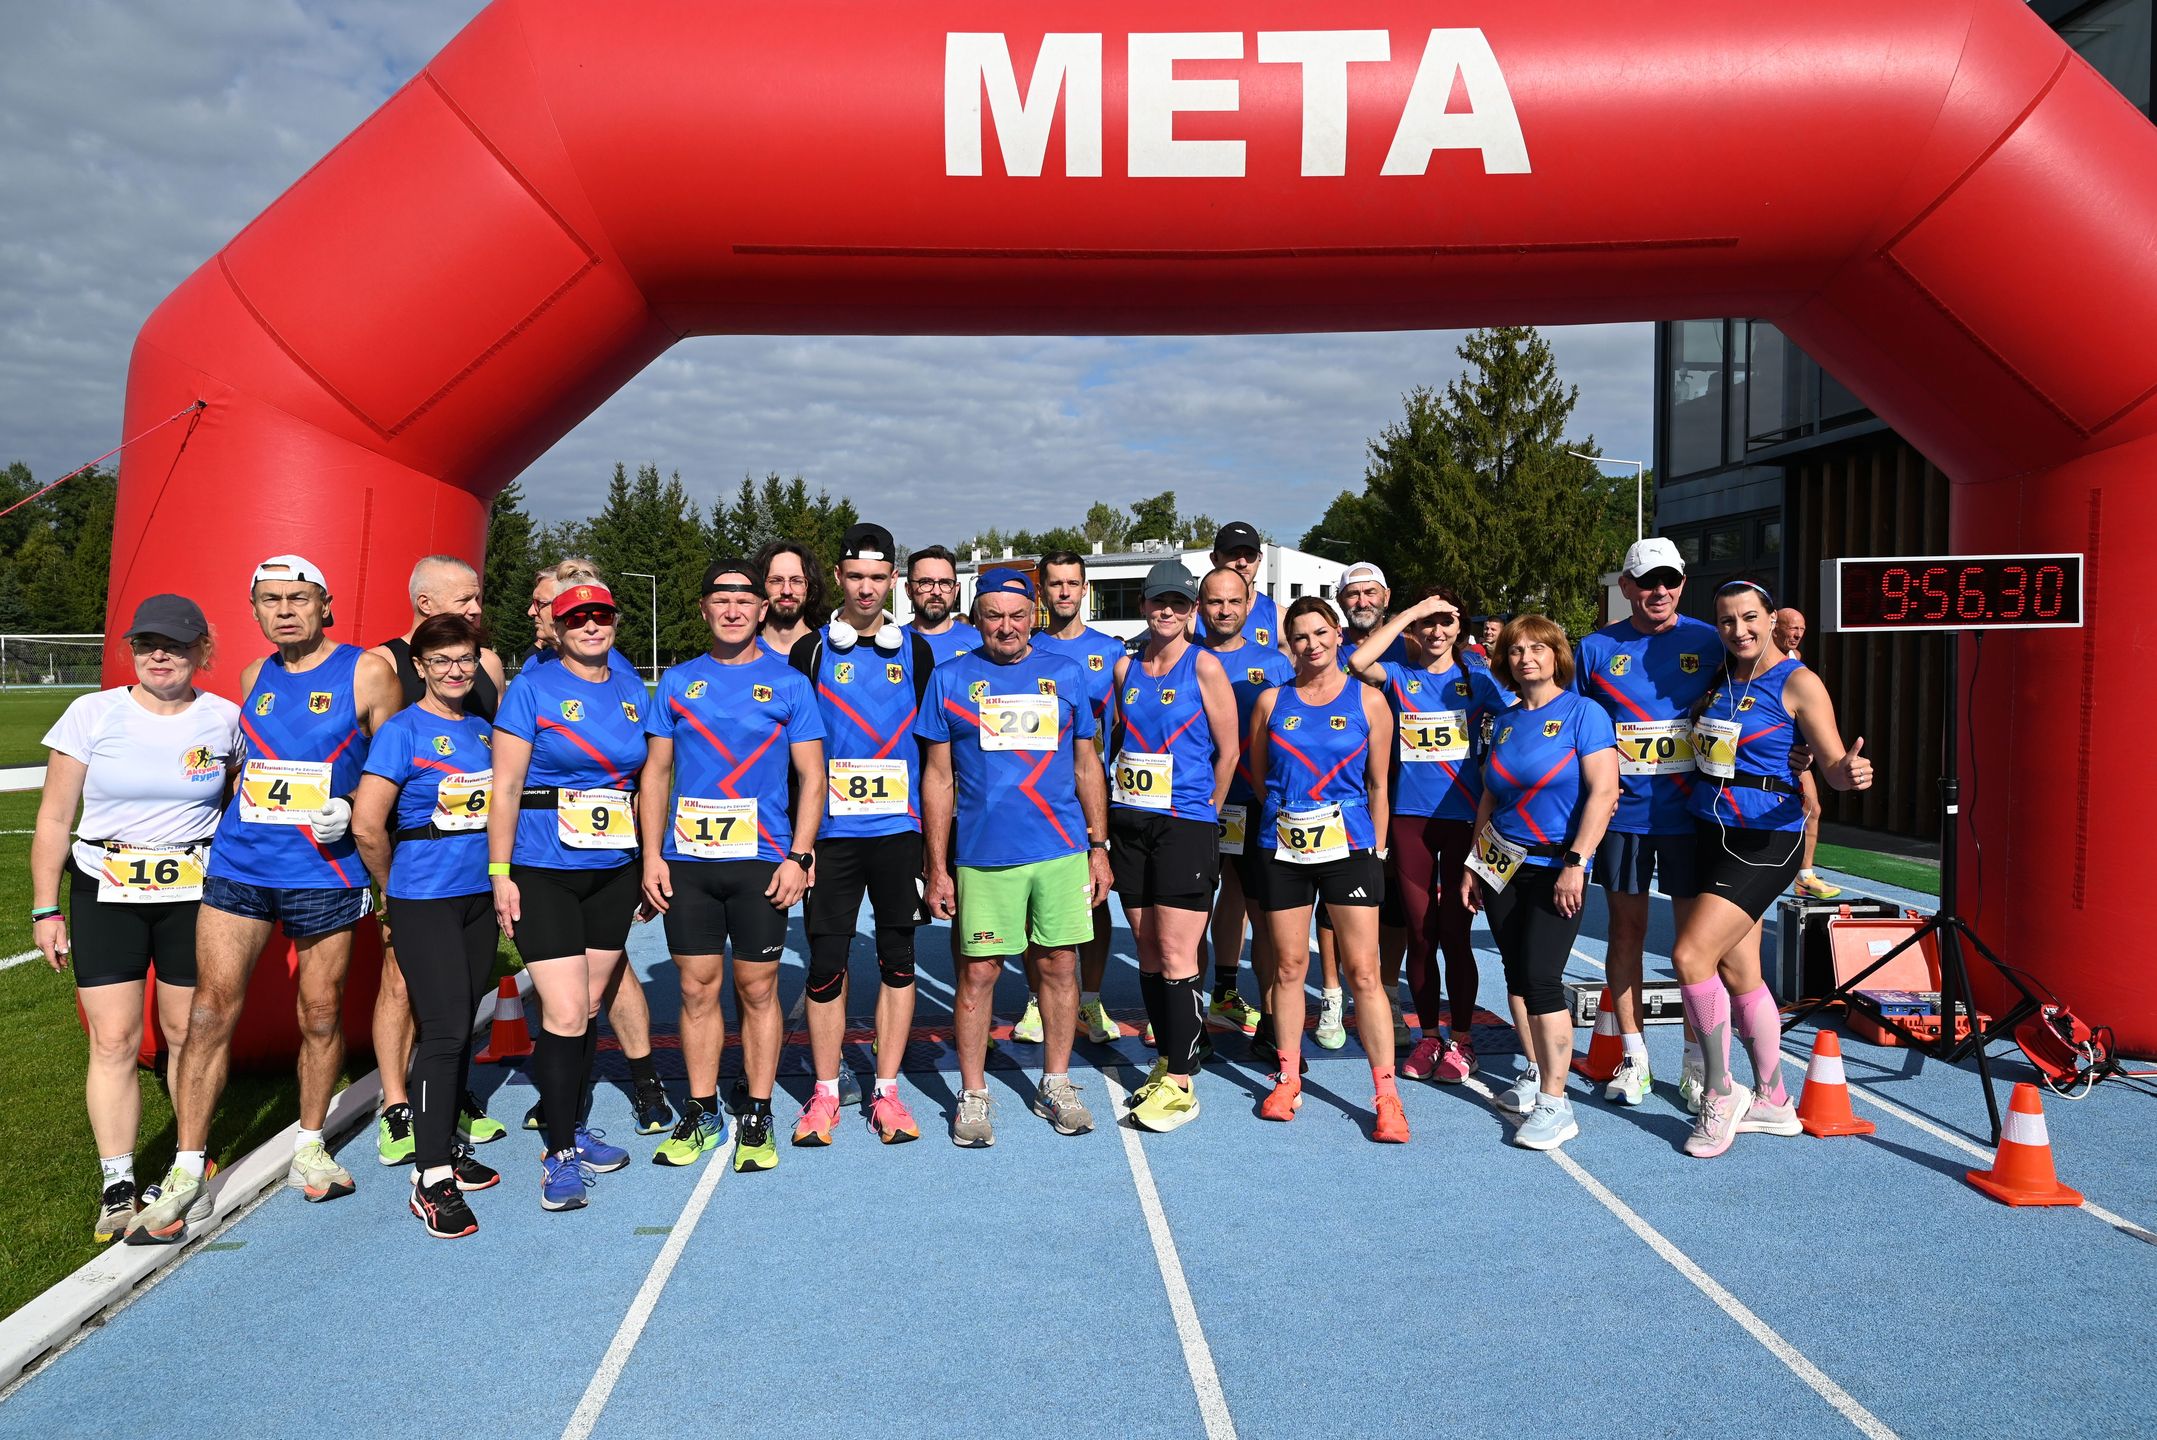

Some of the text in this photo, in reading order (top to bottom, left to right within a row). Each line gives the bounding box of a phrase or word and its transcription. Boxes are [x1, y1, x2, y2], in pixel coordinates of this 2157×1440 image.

[944, 27, 1532, 178] META
[837, 665, 851, 680] LECH
[1612, 656, 1628, 672] LECH
[971, 683, 986, 699] LECH
[566, 702, 580, 718] LECH
[999, 710, 1040, 733] 20
[439, 738, 448, 752] LECH
[1416, 726, 1452, 747] 15
[1634, 736, 1676, 760] 70
[191, 770, 220, 782] Rypin
[250, 761, 264, 769] XXI
[848, 775, 889, 798] 81
[1123, 767, 1153, 791] 30
[268, 779, 291, 805] 4
[466, 789, 486, 812] 6
[684, 800, 698, 808] XXI
[591, 806, 610, 831] 9
[695, 817, 736, 841] 17
[1289, 824, 1326, 849] 87
[1485, 844, 1511, 874] 58
[128, 858, 179, 885] 16
